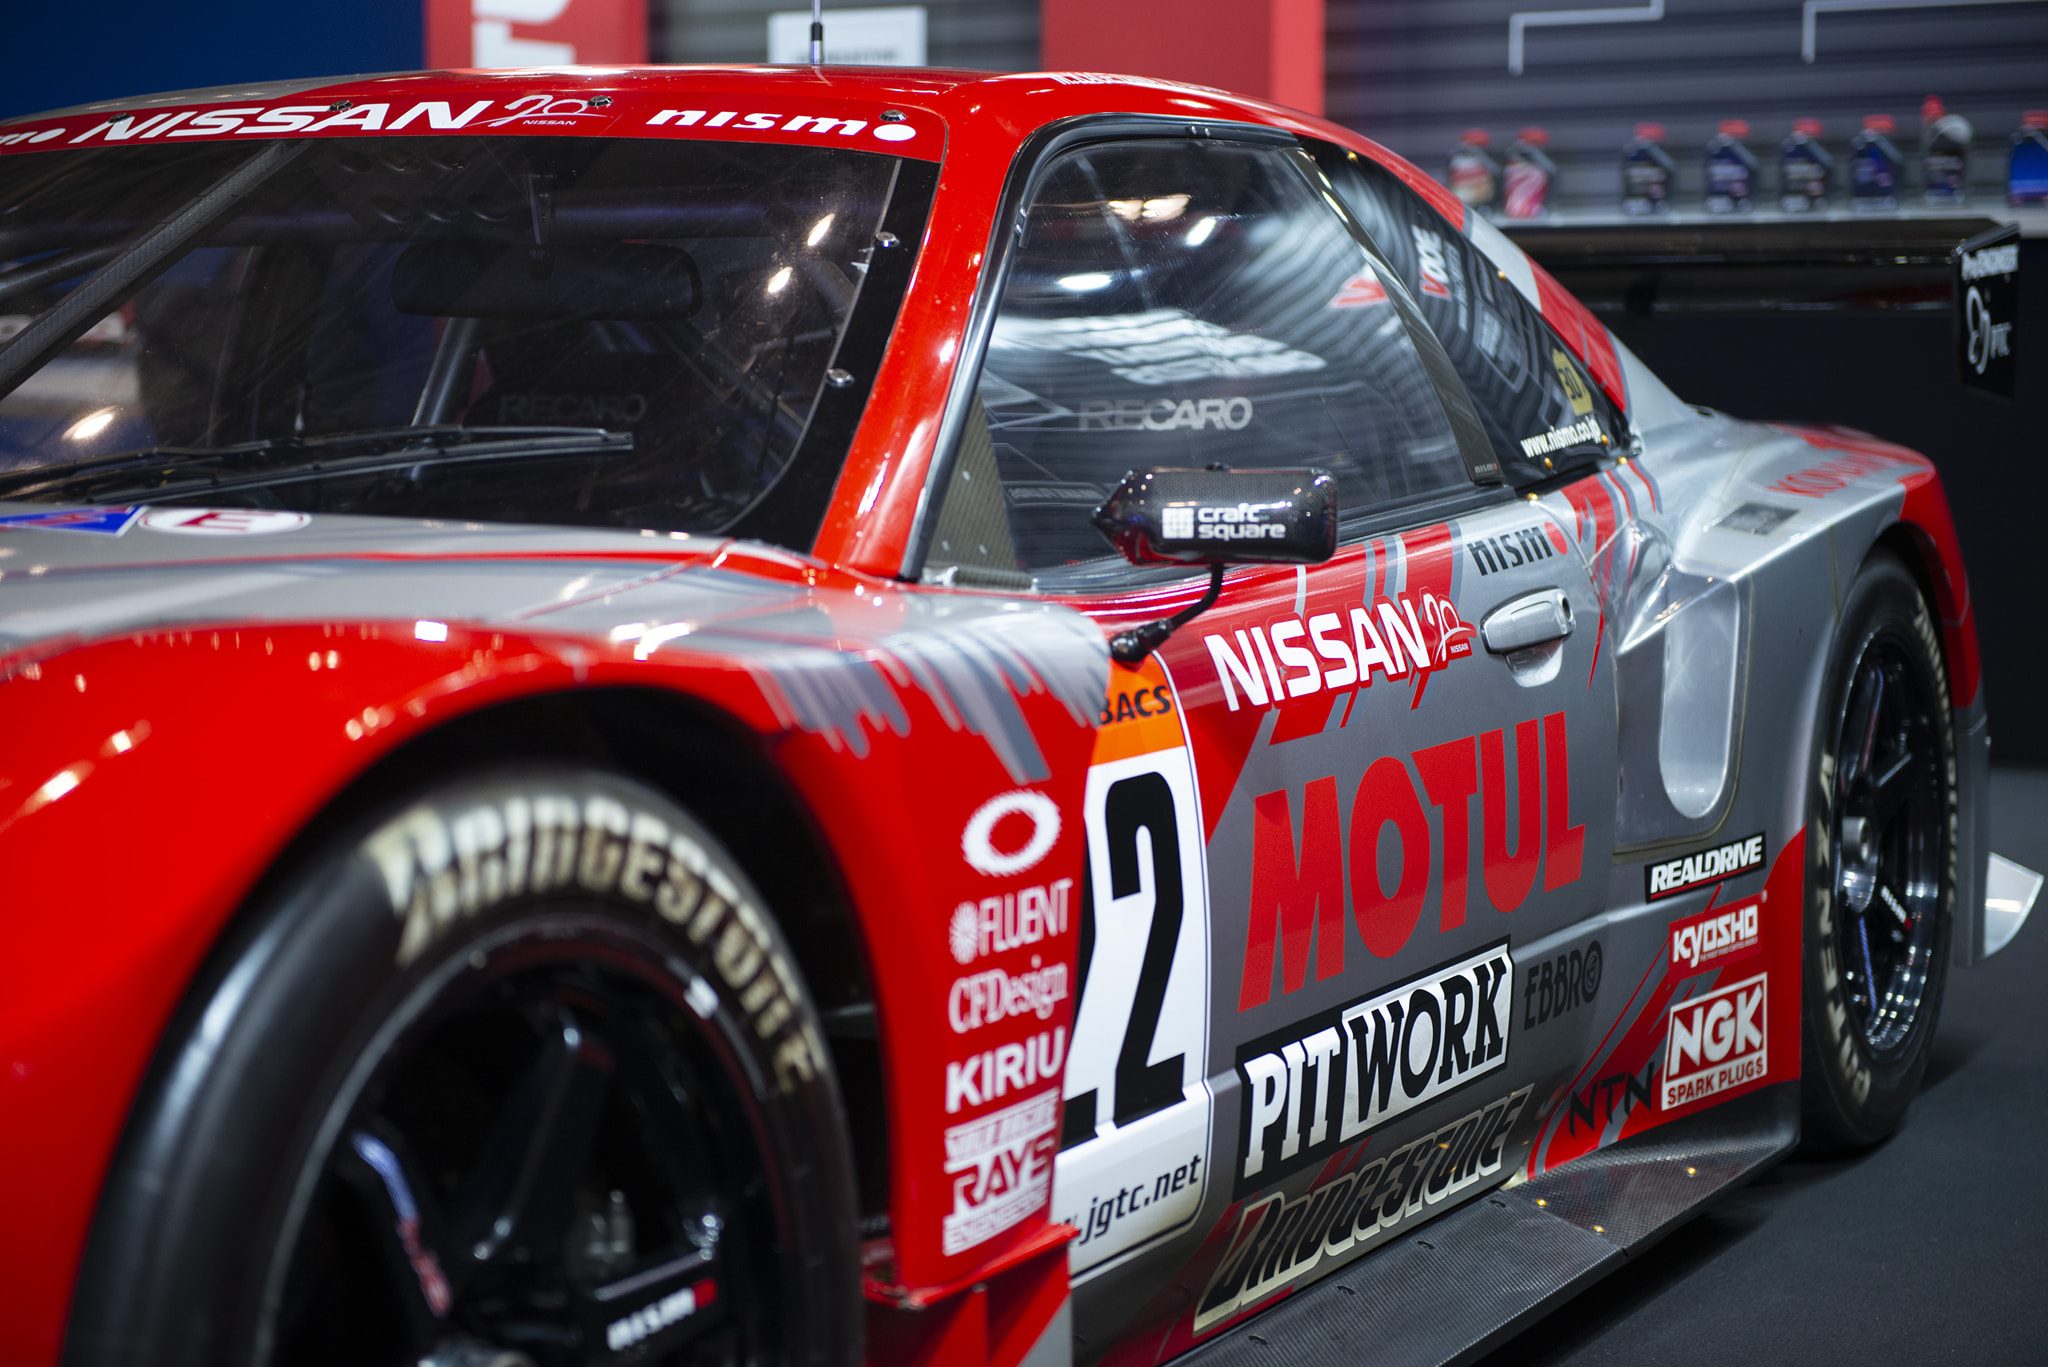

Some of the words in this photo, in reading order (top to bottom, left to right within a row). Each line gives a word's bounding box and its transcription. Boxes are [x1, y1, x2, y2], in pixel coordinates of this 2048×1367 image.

[68, 100, 495, 144] NISSAN
[646, 109, 917, 141] nismo
[1079, 397, 1253, 432] RECARO
[1520, 415, 1603, 458] www.nismo.co.jp
[174, 509, 277, 532] E
[1198, 524, 1286, 541] square
[1466, 521, 1569, 577] nismo
[1203, 599, 1431, 712] NISSAN
[1450, 643, 1469, 654] NISSAN
[1238, 710, 1587, 1013] MOTUL
[1650, 835, 1762, 894] REALDRIVE
[357, 797, 831, 1094] BRIDGESTONE
[979, 878, 1074, 957] FLUENT
[1673, 904, 1759, 968] KYOSHO
[948, 954, 1069, 1034] CFDesign
[1669, 984, 1764, 1077] NGK
[945, 1025, 1066, 1115] KIRIU
[1667, 1073, 1715, 1107] SPARK
[1718, 1056, 1764, 1085] PLUGS
[1568, 1061, 1656, 1139] NTN
